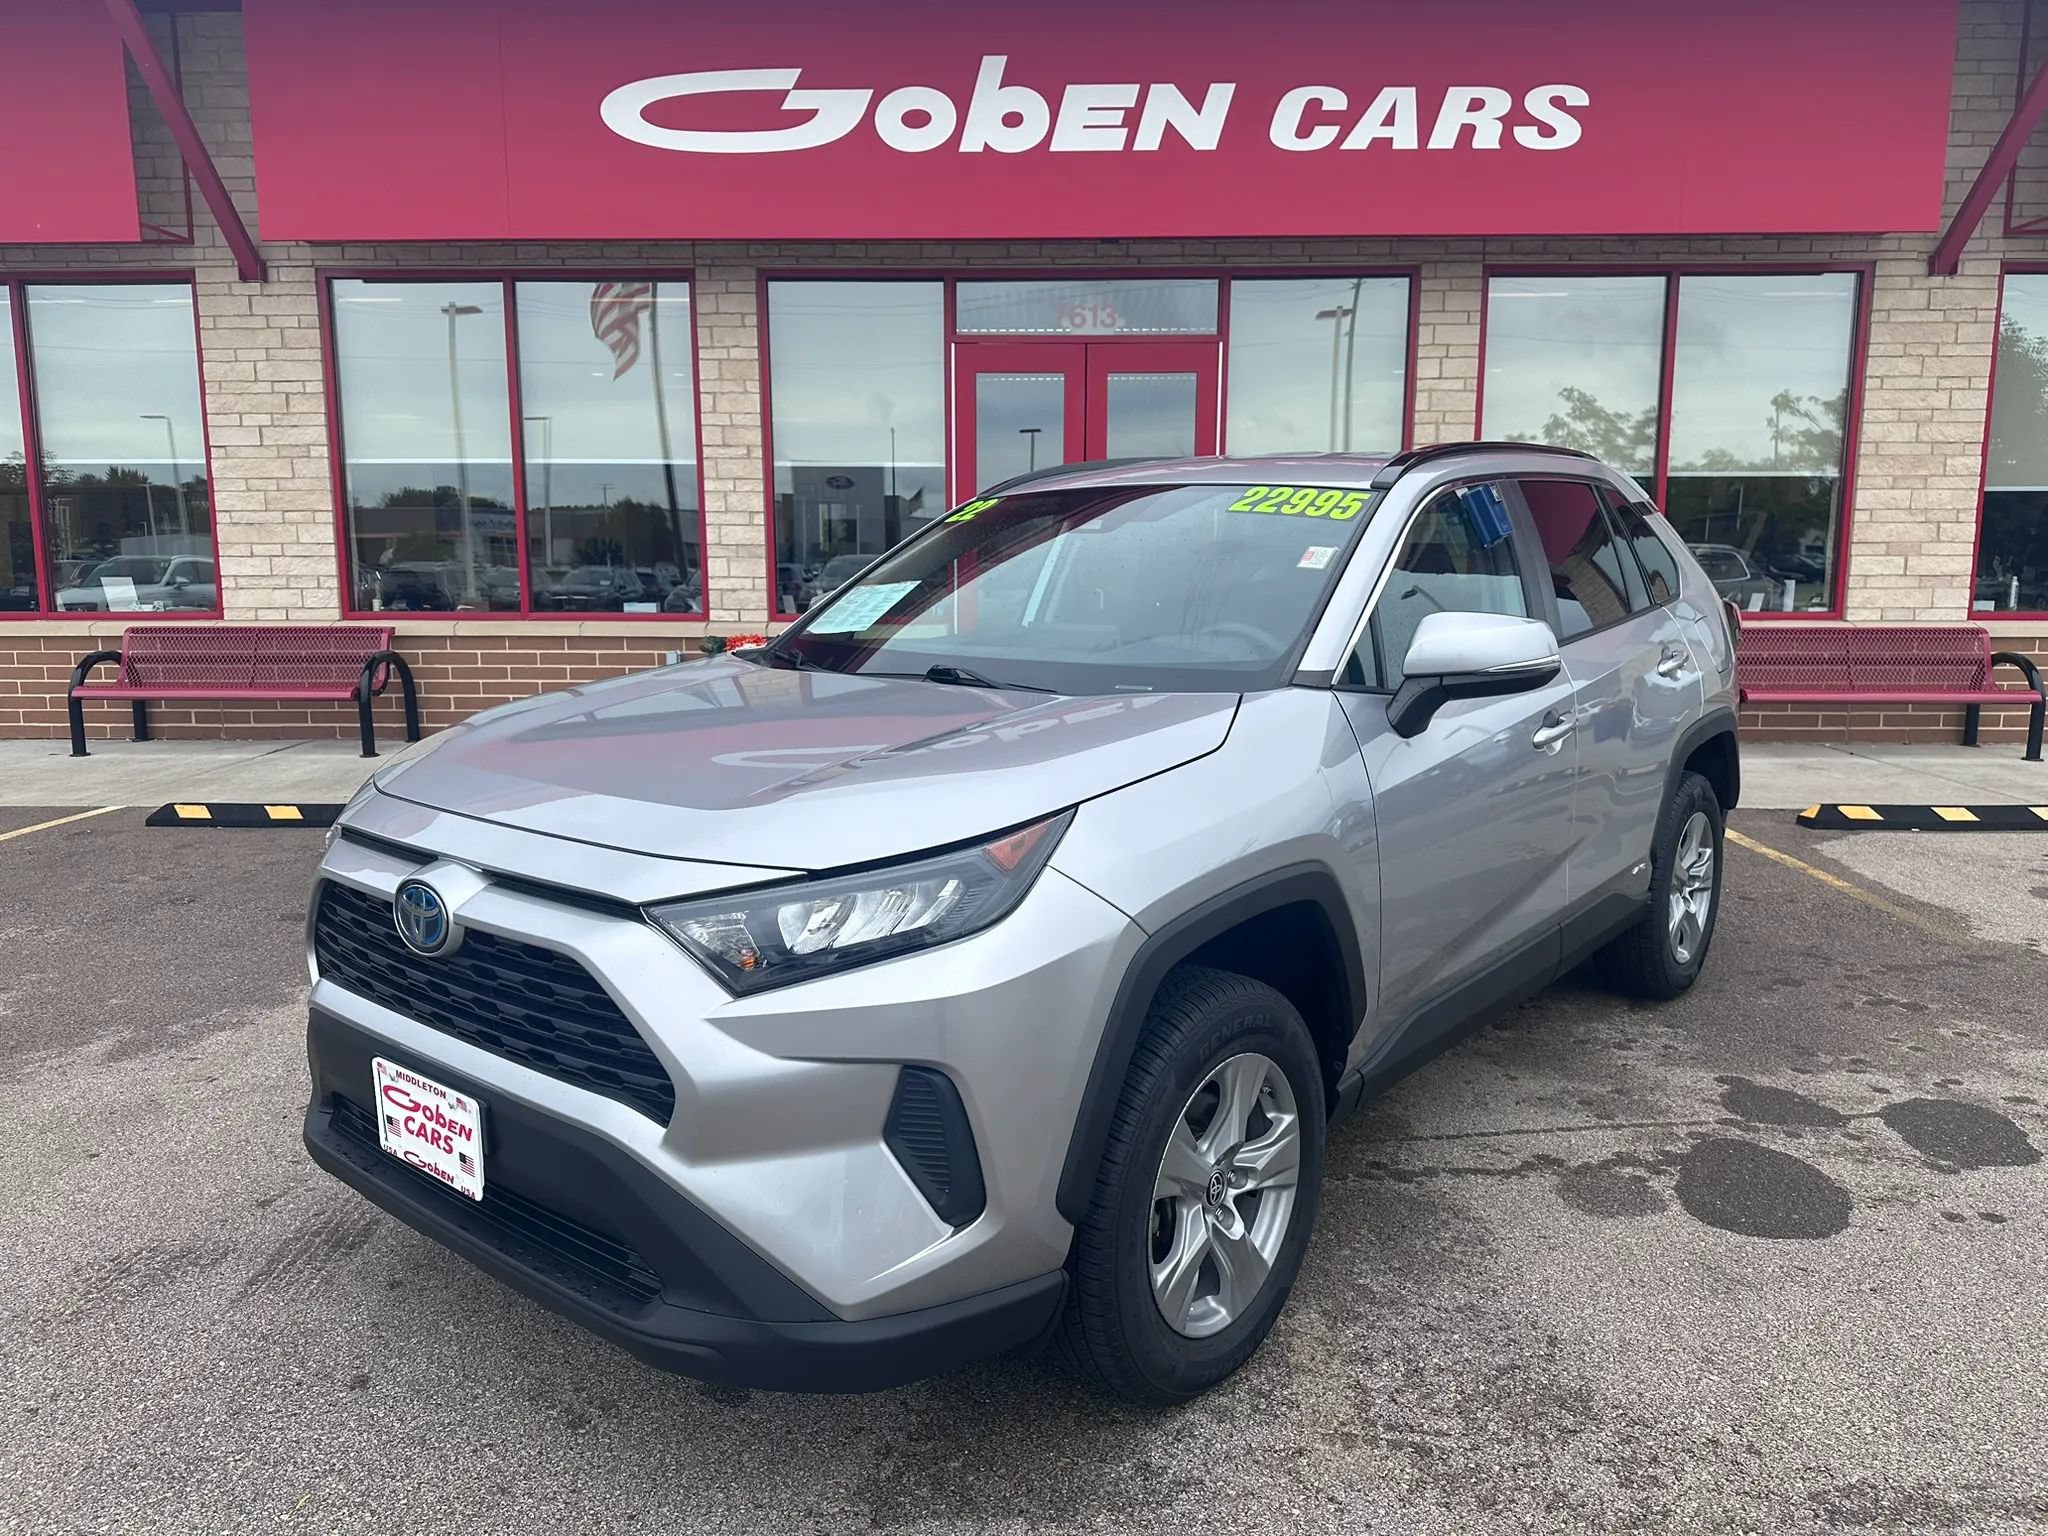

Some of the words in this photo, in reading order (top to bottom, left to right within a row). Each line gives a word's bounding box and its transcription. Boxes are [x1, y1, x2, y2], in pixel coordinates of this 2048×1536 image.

[1268, 83, 1591, 153] CARS
[943, 498, 999, 523] 22
[1228, 486, 1371, 520] 22995
[1201, 1014, 1272, 1063] GENERAL
[395, 1069, 446, 1099] MIDDLETON
[383, 1144, 398, 1157] USA
[404, 1116, 453, 1154] CARS
[461, 1186, 476, 1200] USA
